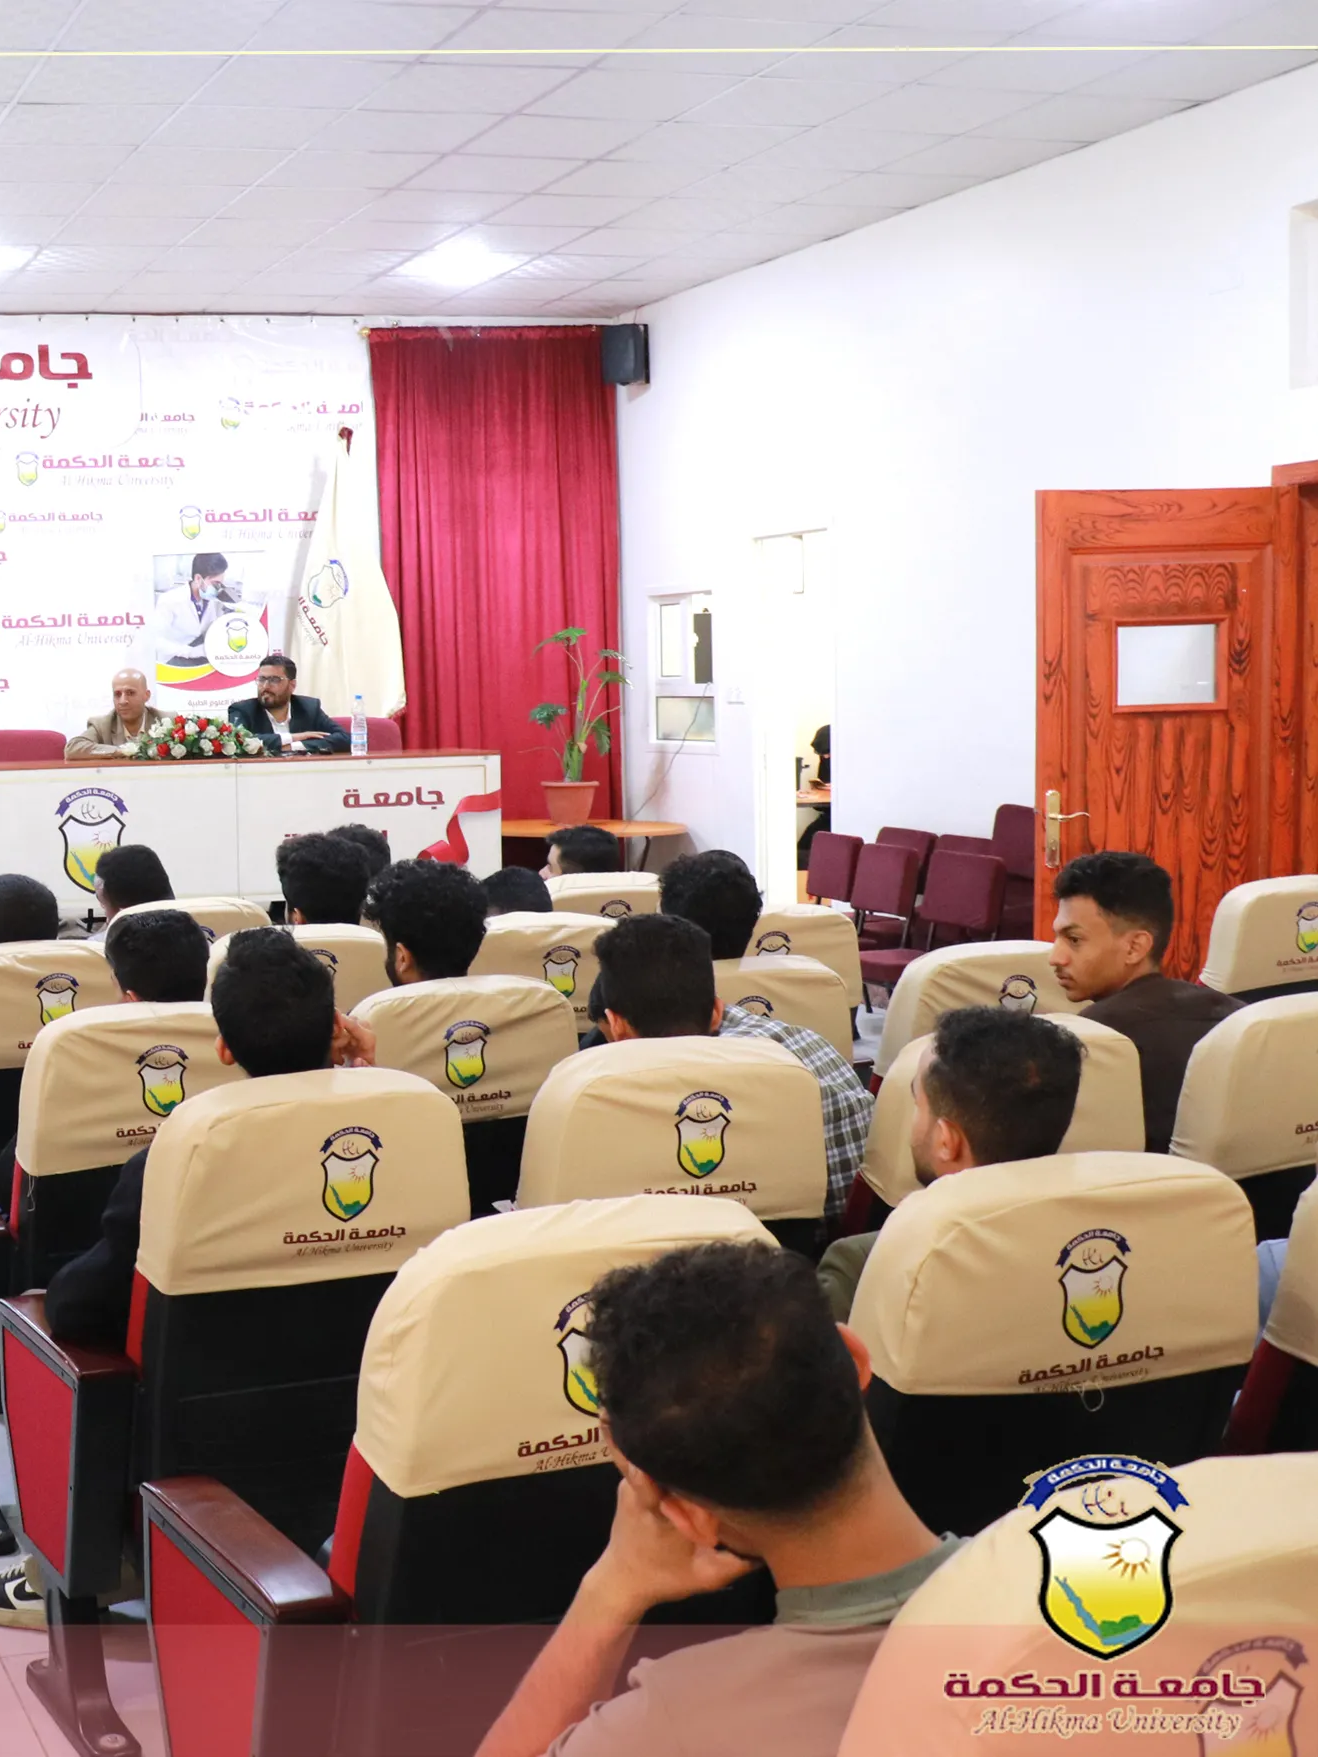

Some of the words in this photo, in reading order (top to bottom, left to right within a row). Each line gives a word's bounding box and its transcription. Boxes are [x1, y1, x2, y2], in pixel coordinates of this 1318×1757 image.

[42, 455, 113, 470] الحكمة
[205, 509, 273, 523] الحكمة
[1, 613, 73, 629] الحكمة
[77, 612, 146, 629] جامعة
[77, 632, 135, 648] University
[65, 788, 93, 803] الحكمة
[93, 787, 119, 802] جامعة
[343, 786, 445, 810] جامعة
[468, 1089, 512, 1102] جامعة
[703, 1181, 757, 1196] جامعة
[283, 1229, 346, 1246] الحكمة
[348, 1225, 406, 1242] جامعة
[1095, 1345, 1165, 1371] جامعة
[1018, 1357, 1092, 1386] الحكمة
[517, 1427, 600, 1458] الحكمة
[534, 1450, 597, 1472] Al-Hikma
